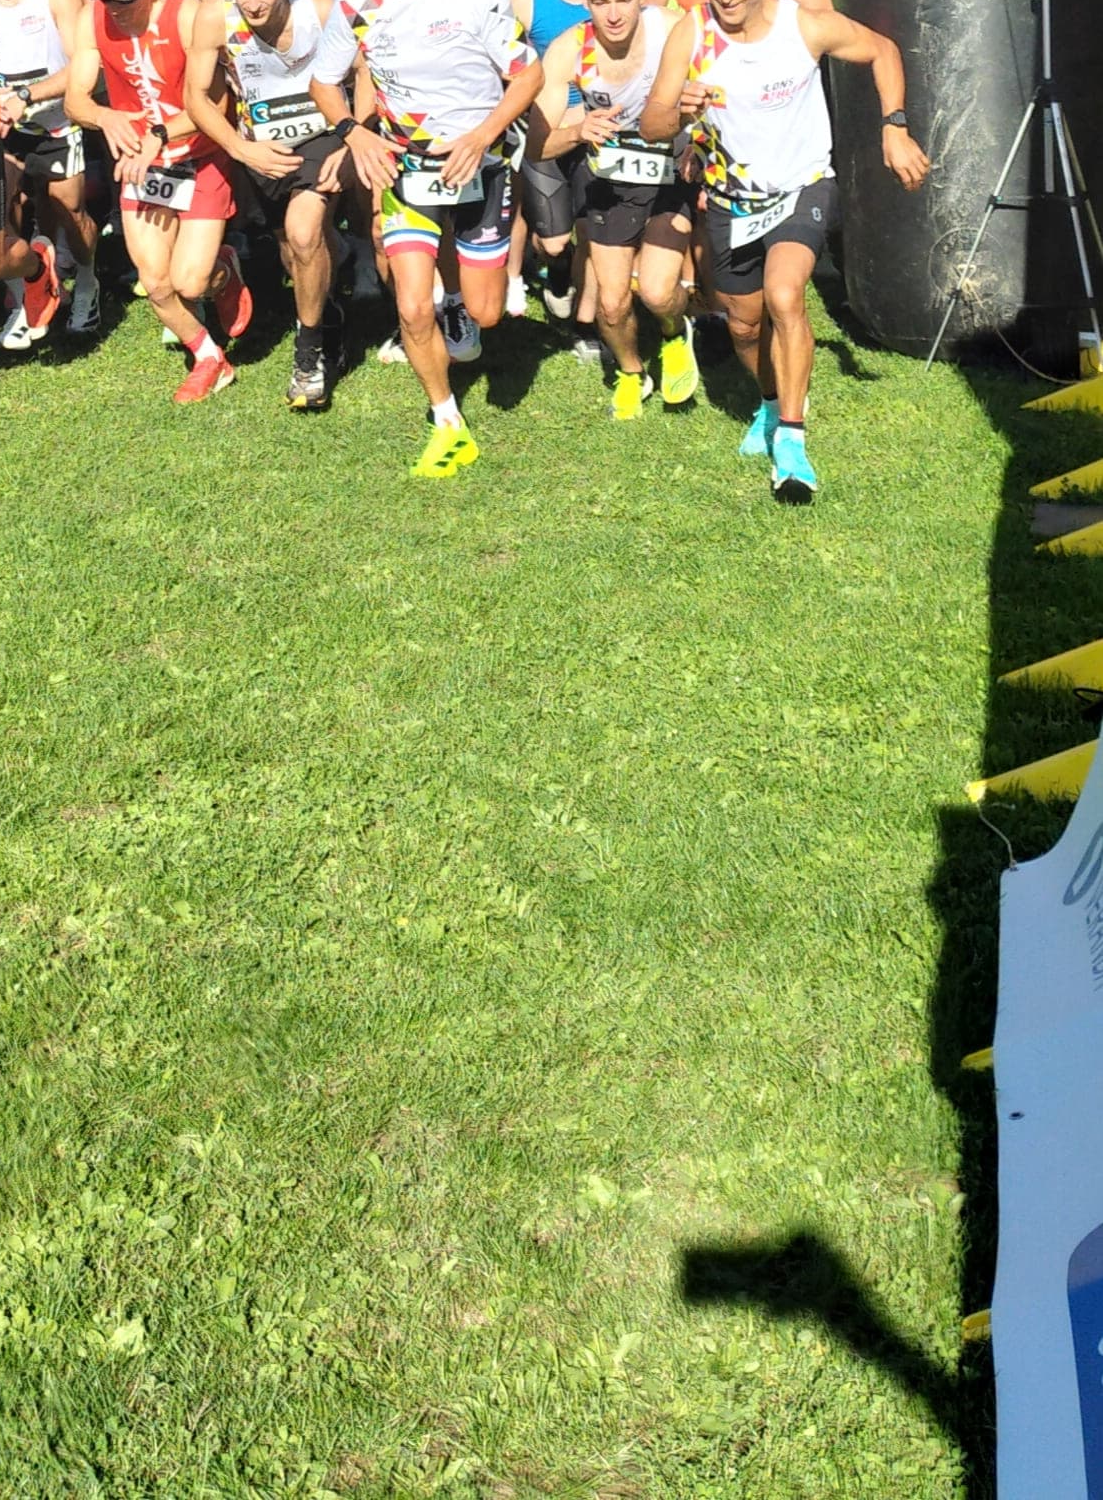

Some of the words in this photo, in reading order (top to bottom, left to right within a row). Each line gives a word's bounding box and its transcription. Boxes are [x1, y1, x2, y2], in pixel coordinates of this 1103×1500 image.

[268, 122, 314, 140] 203
[616, 156, 659, 177] 113
[746, 203, 785, 238] 269
